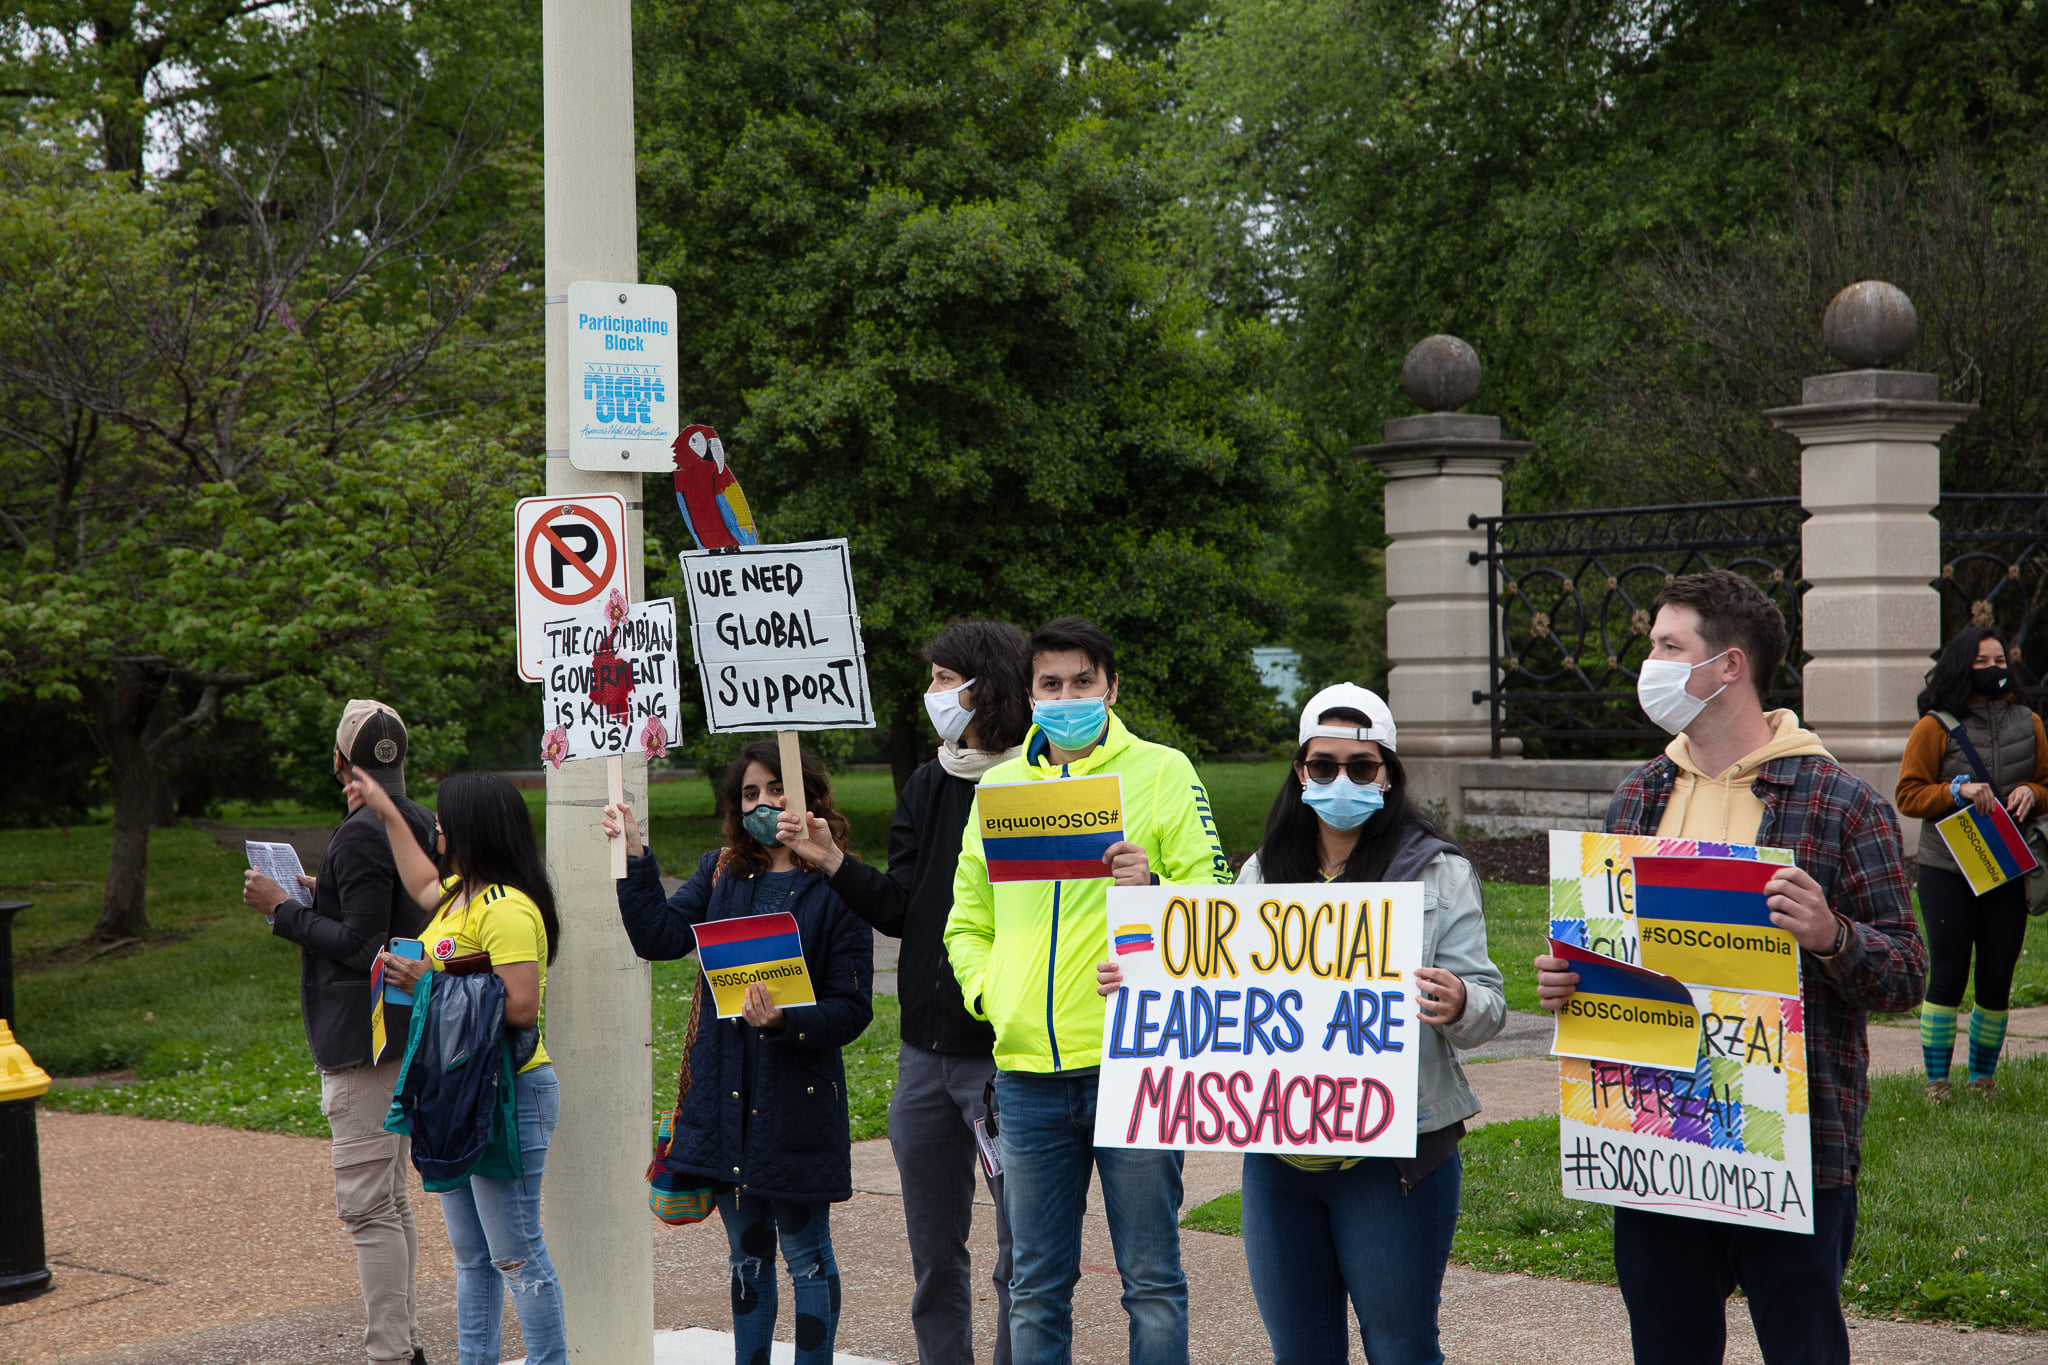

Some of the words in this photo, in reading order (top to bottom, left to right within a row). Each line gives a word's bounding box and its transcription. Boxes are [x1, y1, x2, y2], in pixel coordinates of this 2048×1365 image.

[579, 313, 668, 336] Participating
[605, 334, 644, 352] Block
[588, 365, 658, 374] NATIONAL
[550, 524, 598, 588] P
[697, 569, 737, 598] WE
[741, 563, 803, 597] NEED
[547, 625, 581, 659] THE
[716, 609, 829, 650] GLOBAL
[551, 653, 666, 695] GOVERMENT
[718, 659, 854, 715] SUPPORT
[591, 725, 632, 752] US!
[986, 809, 1120, 832] #SOSColombia
[1957, 815, 2000, 883] #SOSColombia
[1161, 896, 1239, 978] OUR
[1249, 899, 1401, 982] SOCIAL
[1642, 926, 1791, 956] #SOSColombia
[711, 964, 803, 988] #SOSColombia
[1109, 985, 1303, 1059] LEADERS
[1322, 989, 1404, 1055] ARE
[1560, 999, 1694, 1028] #SOSColombia
[1701, 1012, 1783, 1074] RZA!
[1126, 1066, 1395, 1147] MASSACRED
[1564, 1136, 1806, 1217] #SOSCOLOMBIA
